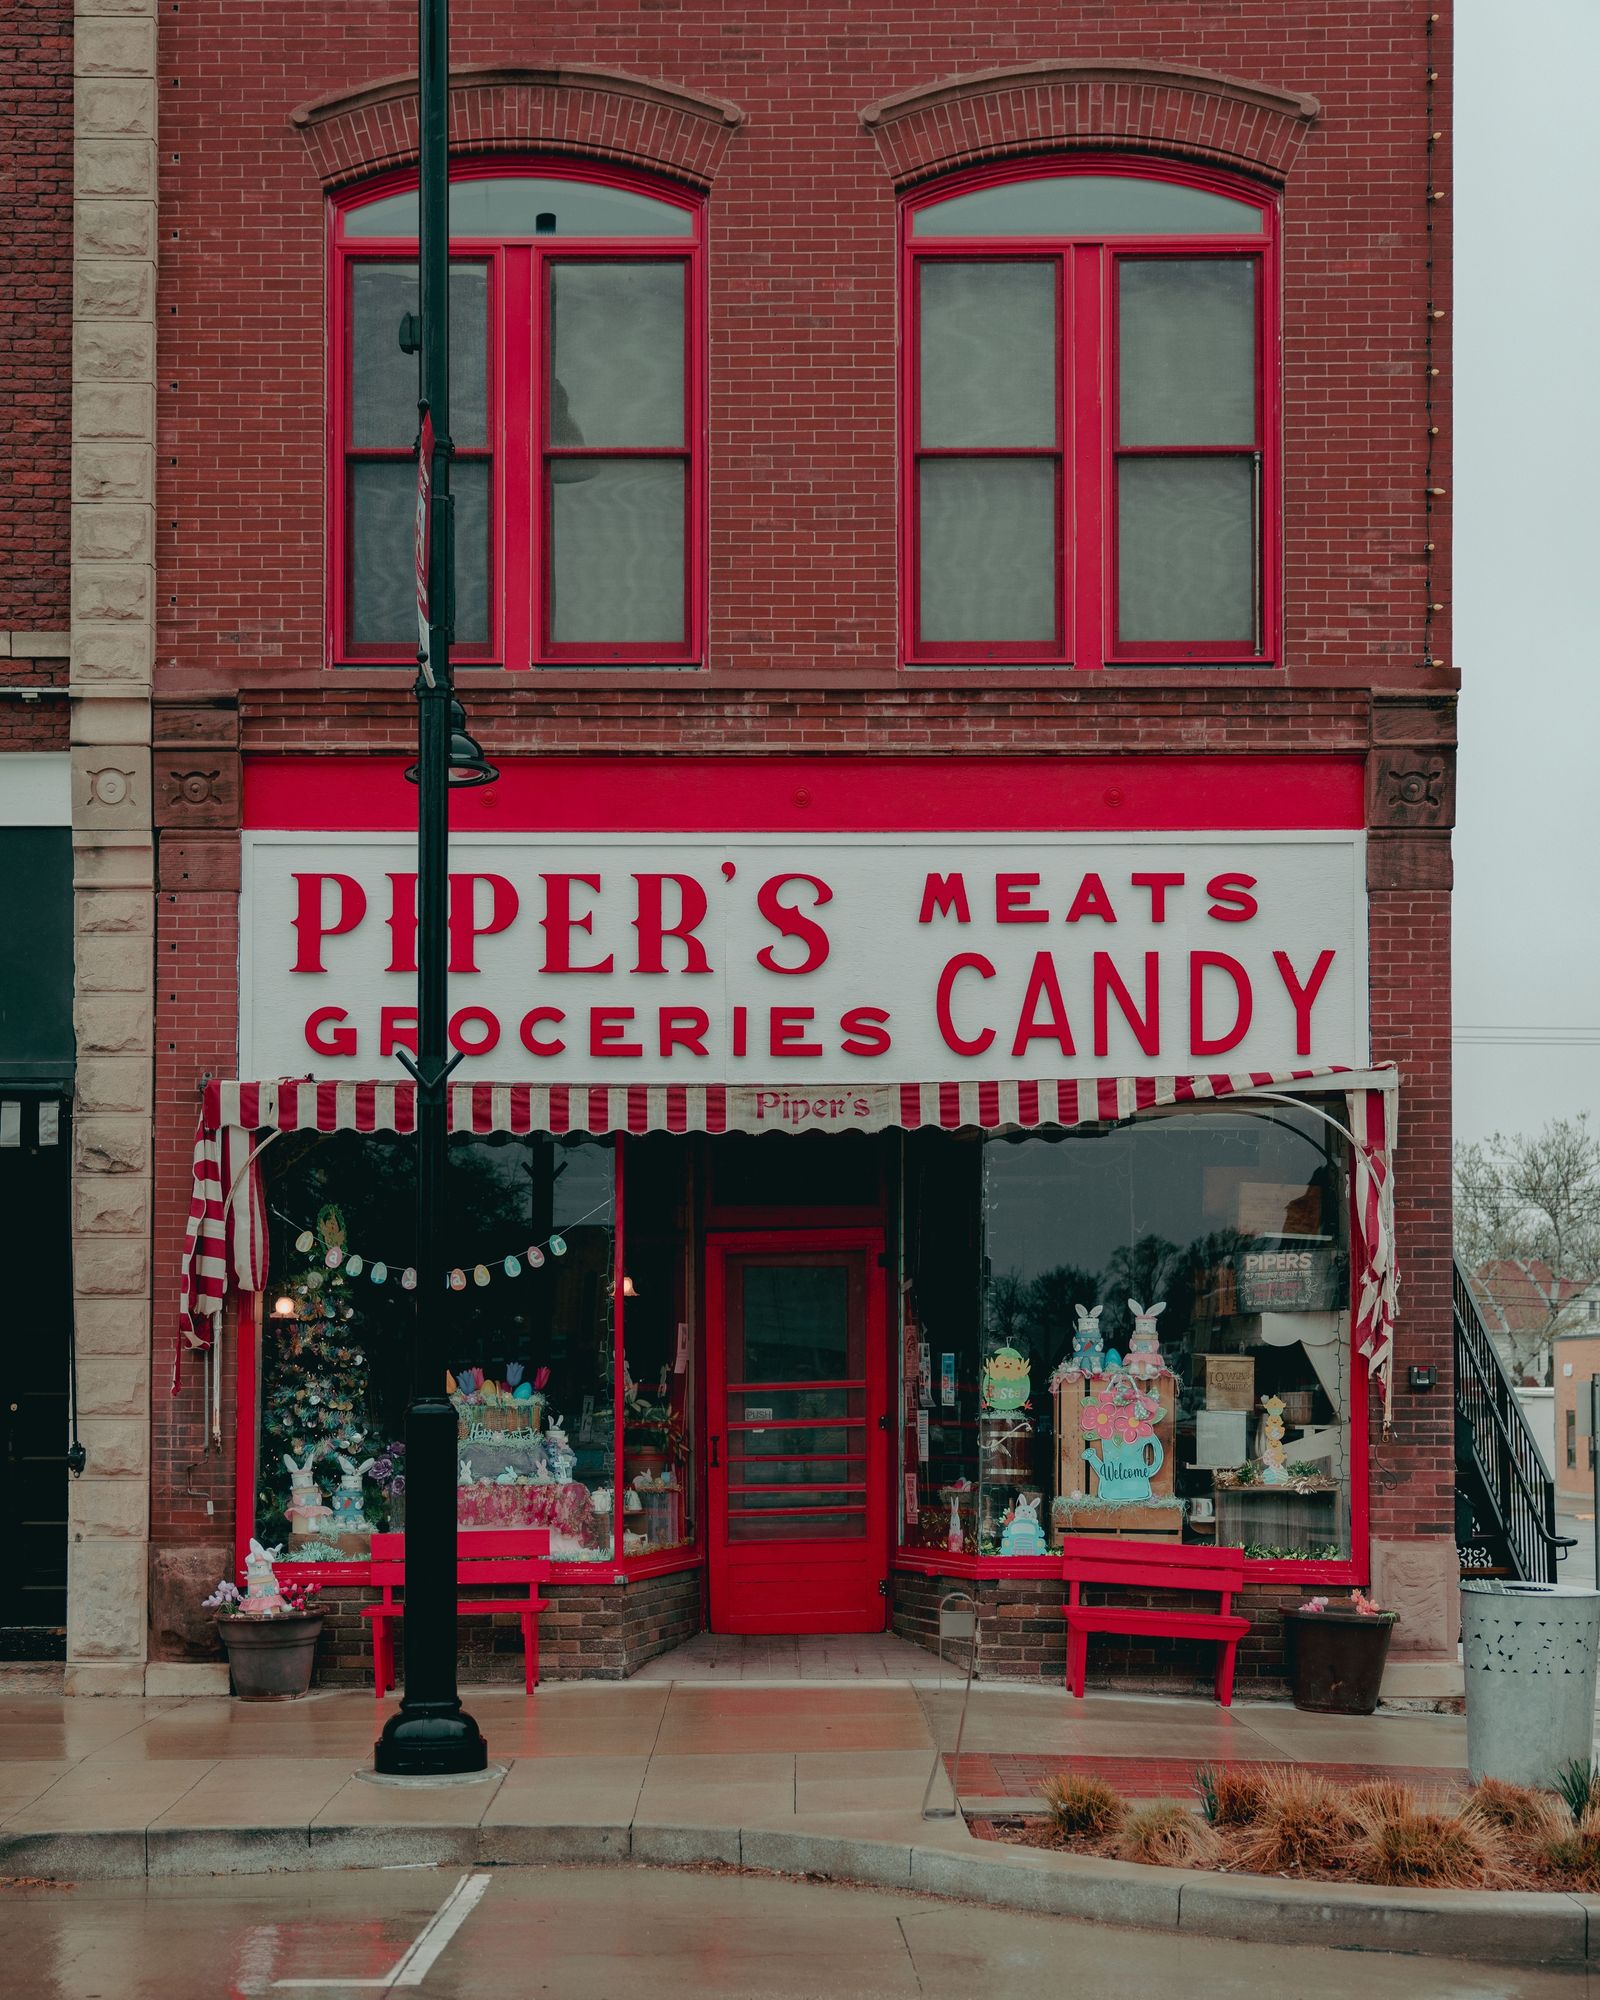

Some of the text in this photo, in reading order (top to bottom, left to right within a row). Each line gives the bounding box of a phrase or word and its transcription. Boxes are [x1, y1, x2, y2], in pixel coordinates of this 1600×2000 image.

[290, 862, 833, 974] PIPER'S
[919, 872, 1258, 923] MEATS
[936, 950, 1336, 1057] CANDY
[305, 1006, 891, 1057] GROCERIES
[756, 1091, 870, 1124] Piper's
[1246, 1252, 1313, 1271] PIPERS
[1100, 1462, 1149, 1481] Welcome
